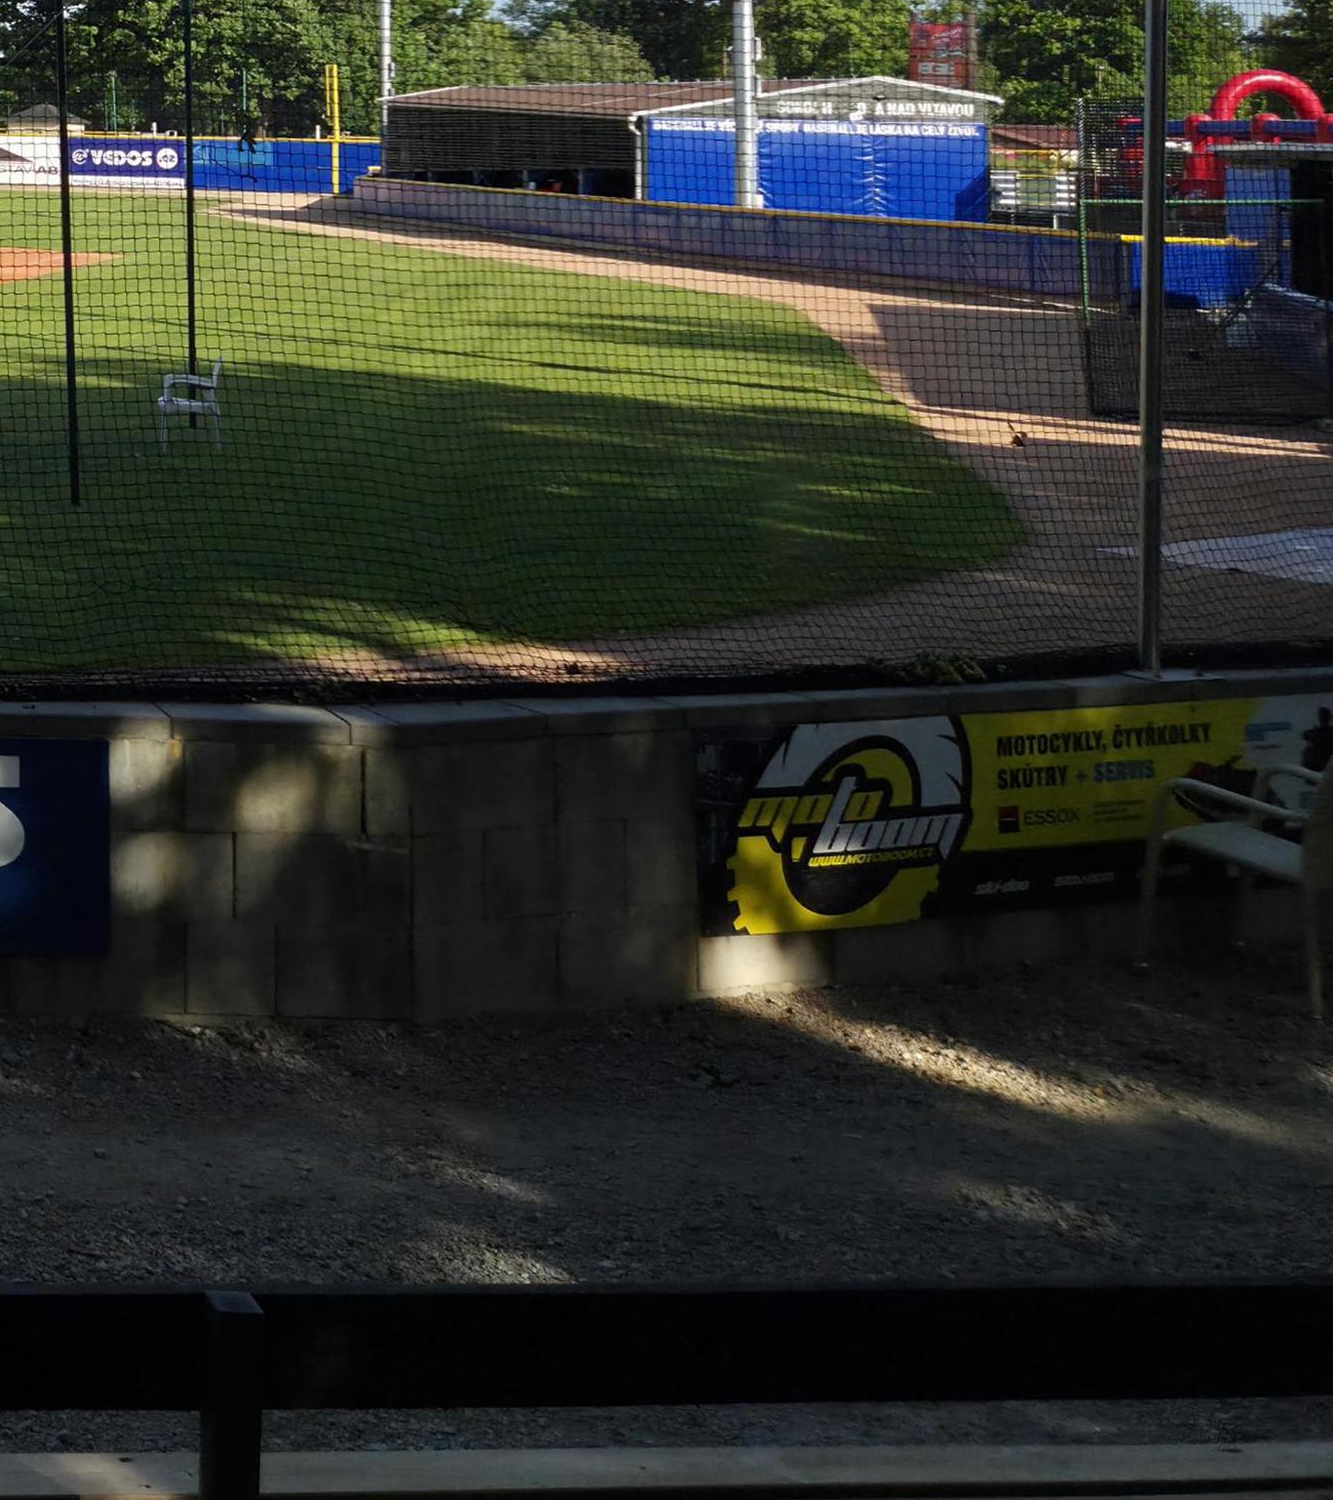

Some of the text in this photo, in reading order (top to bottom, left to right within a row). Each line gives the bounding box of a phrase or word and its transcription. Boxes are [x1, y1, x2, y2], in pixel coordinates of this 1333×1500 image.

[997, 723, 1211, 757] MOTOCYKLY, ČTYŘKOLKY
[1024, 808, 1081, 825] ESSOX
